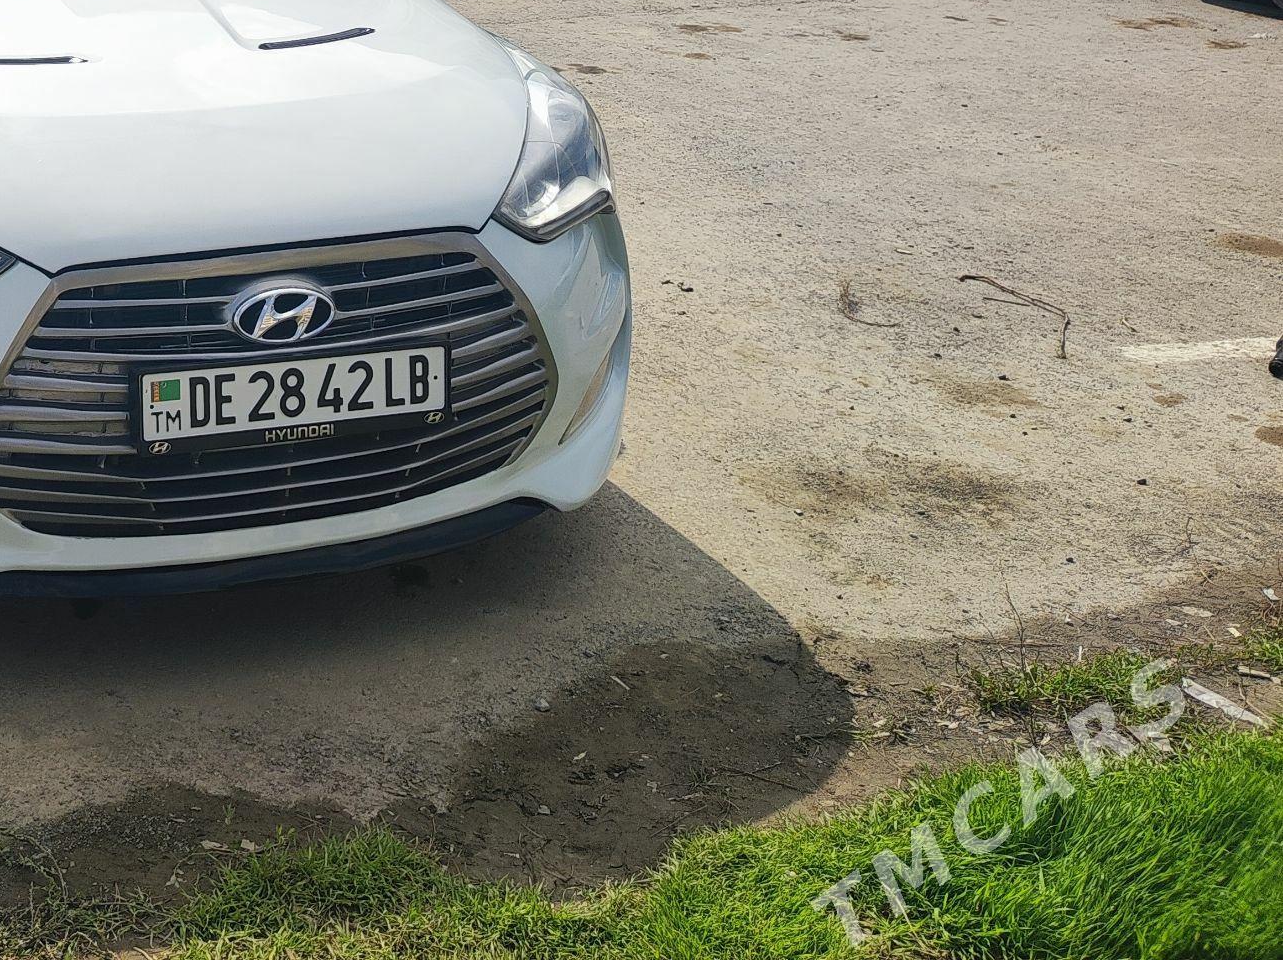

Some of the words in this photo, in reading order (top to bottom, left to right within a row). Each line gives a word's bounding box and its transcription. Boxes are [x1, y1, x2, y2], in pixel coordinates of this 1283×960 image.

[189, 373, 236, 429] DE
[248, 368, 306, 423] 28
[317, 360, 374, 414] 42
[384, 354, 430, 408] LB
[151, 409, 182, 434] TM
[265, 423, 335, 442] HYUNDAI
